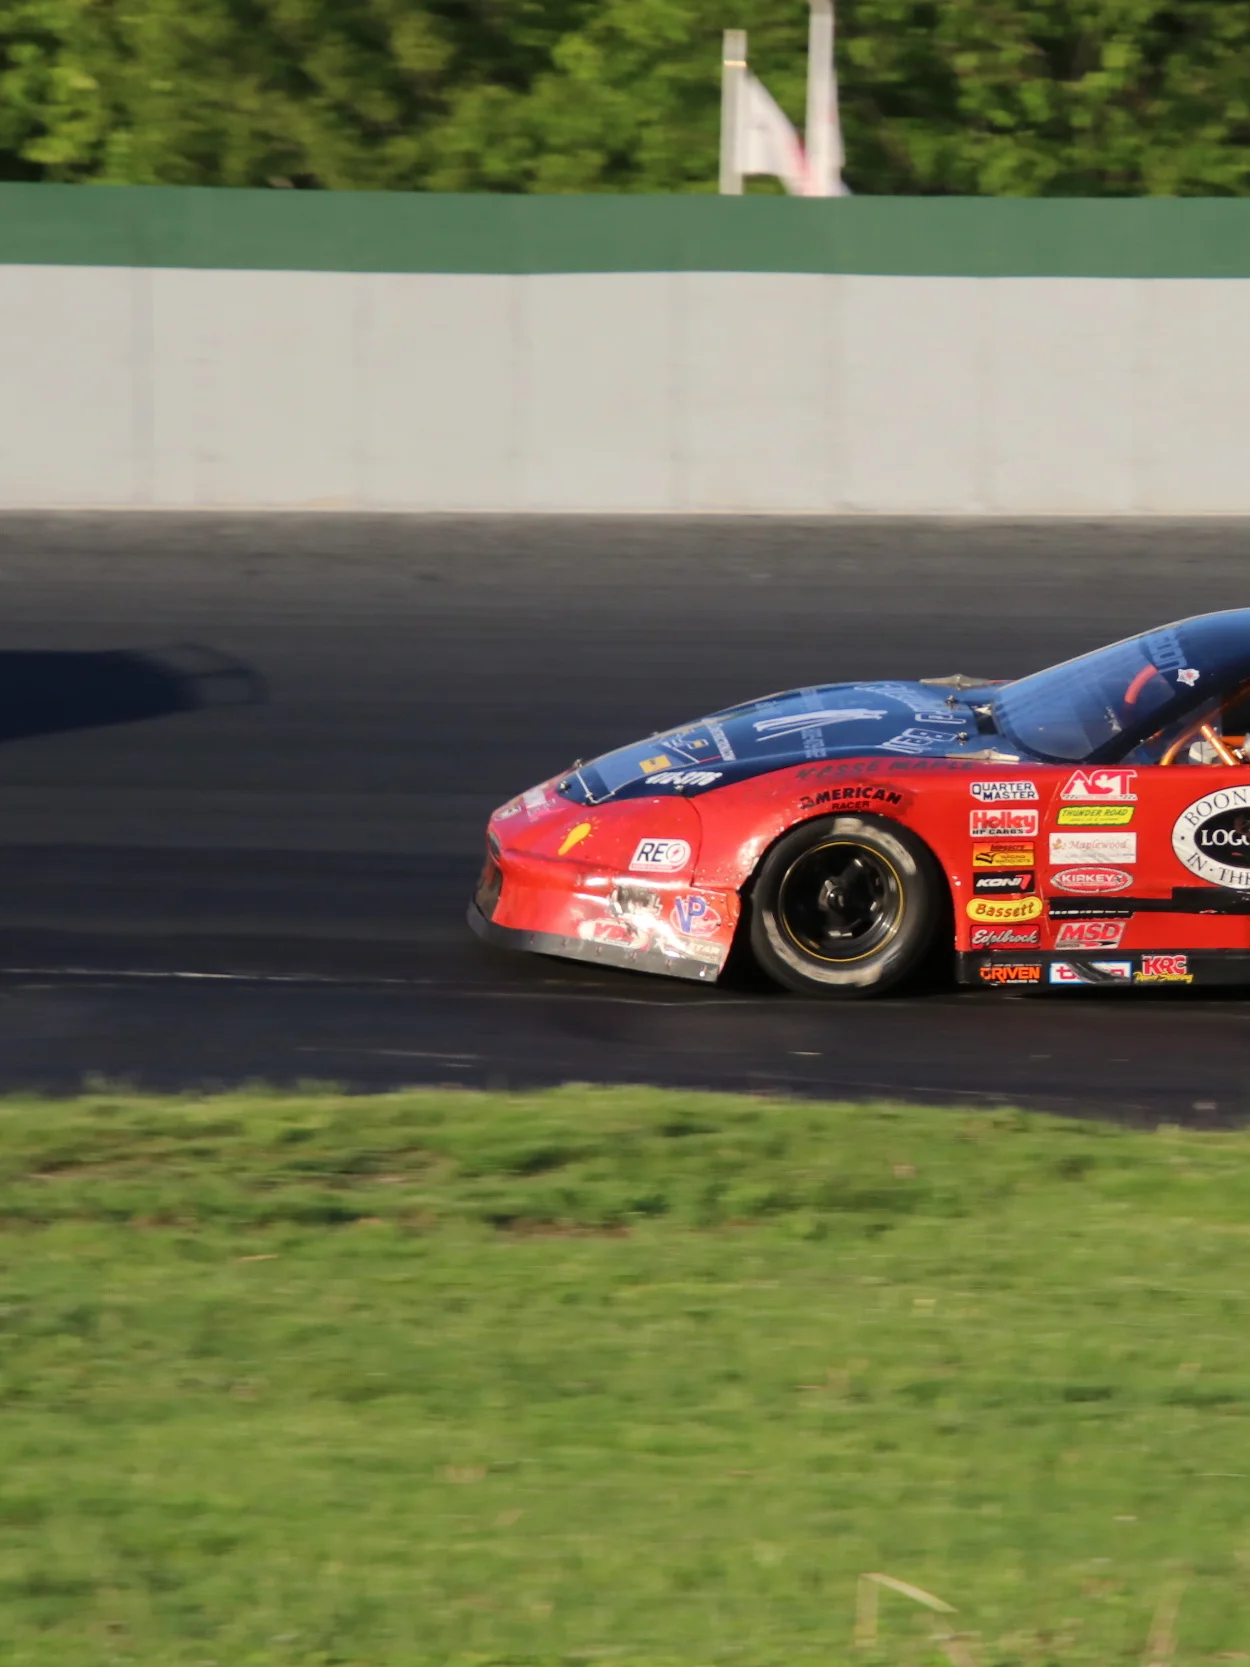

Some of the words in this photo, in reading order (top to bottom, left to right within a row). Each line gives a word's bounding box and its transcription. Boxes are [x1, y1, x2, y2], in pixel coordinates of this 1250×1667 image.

[972, 783, 1032, 794] QUARTER
[1062, 771, 1136, 796] ACT
[800, 786, 902, 810] AMERICAN
[983, 791, 1035, 801] MASTER
[832, 801, 870, 810] RACER
[972, 811, 1036, 834] Holley
[1187, 852, 1207, 871] IN
[1061, 874, 1114, 882] KIRKEY
[676, 896, 706, 933] VP
[976, 902, 1034, 917] Bassett
[1060, 924, 1122, 940] MSD
[1141, 955, 1188, 975] KRC
